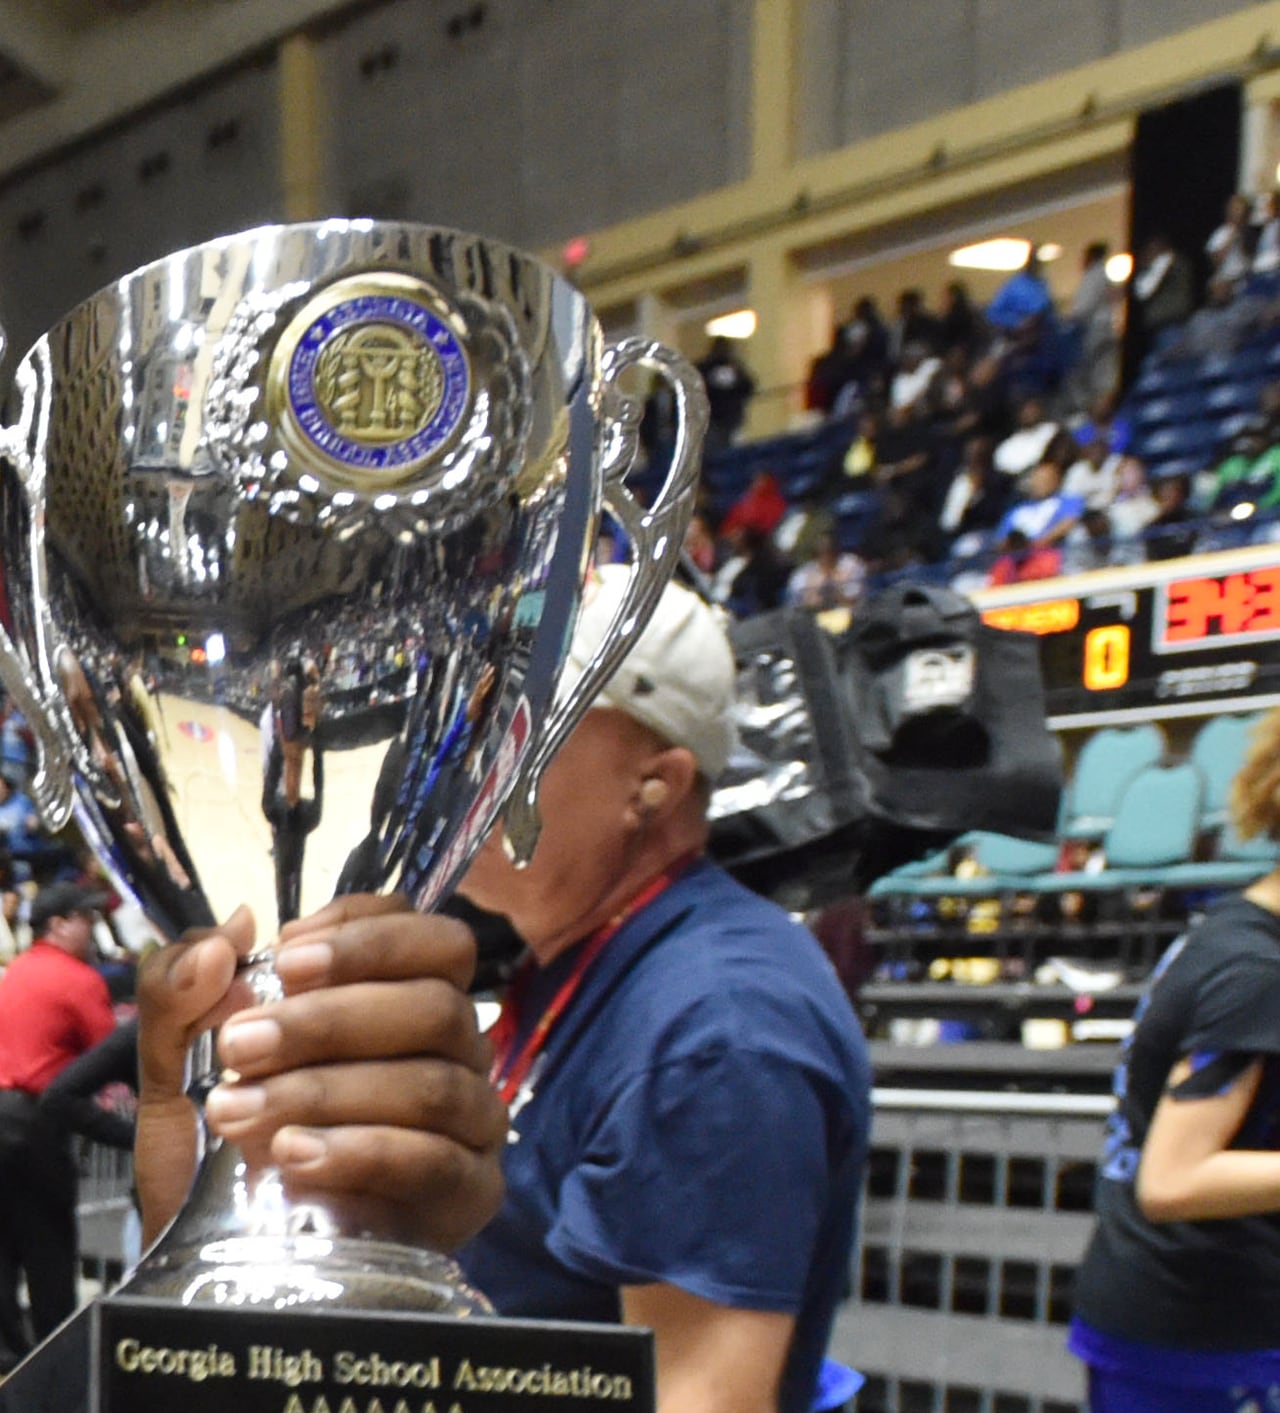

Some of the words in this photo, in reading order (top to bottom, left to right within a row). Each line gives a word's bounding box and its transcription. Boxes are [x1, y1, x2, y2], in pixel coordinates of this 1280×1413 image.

[116, 1338, 237, 1381] Georgia
[248, 1344, 322, 1383] High
[334, 1351, 441, 1390] School
[454, 1358, 633, 1400] Association
